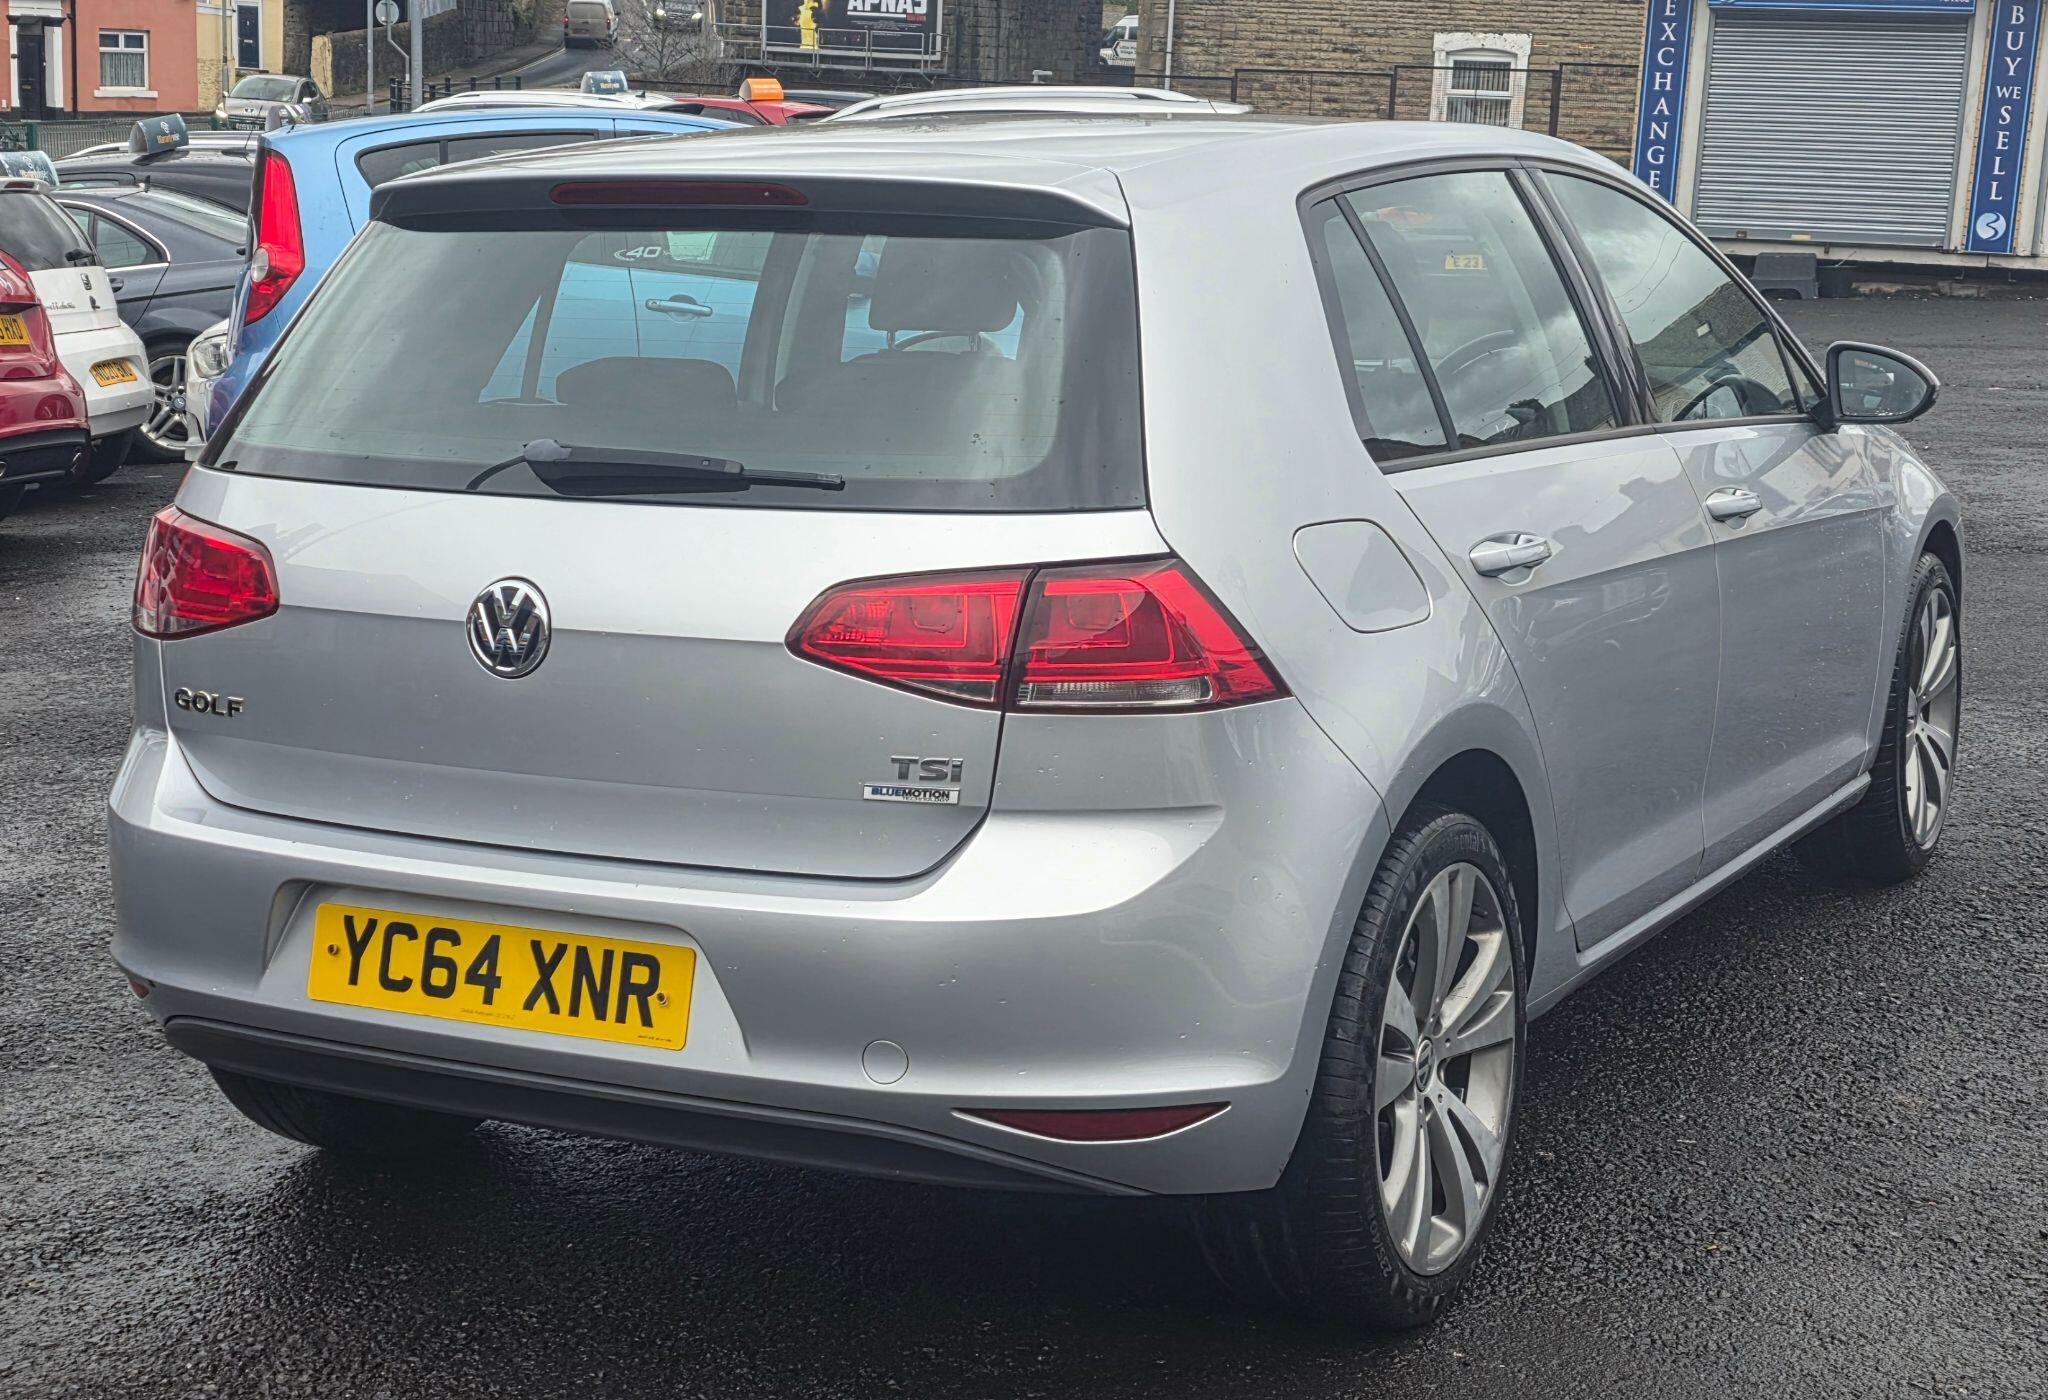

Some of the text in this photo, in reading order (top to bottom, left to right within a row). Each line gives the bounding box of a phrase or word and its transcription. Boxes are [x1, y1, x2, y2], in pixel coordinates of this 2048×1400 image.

[1647, 0, 1678, 189] EXCHANGE
[1989, 5, 2026, 201] BUY WE SELL
[174, 687, 244, 717] GOLF
[871, 787, 950, 798] BLUEMOTION
[343, 914, 661, 1028] YC64 XNR
